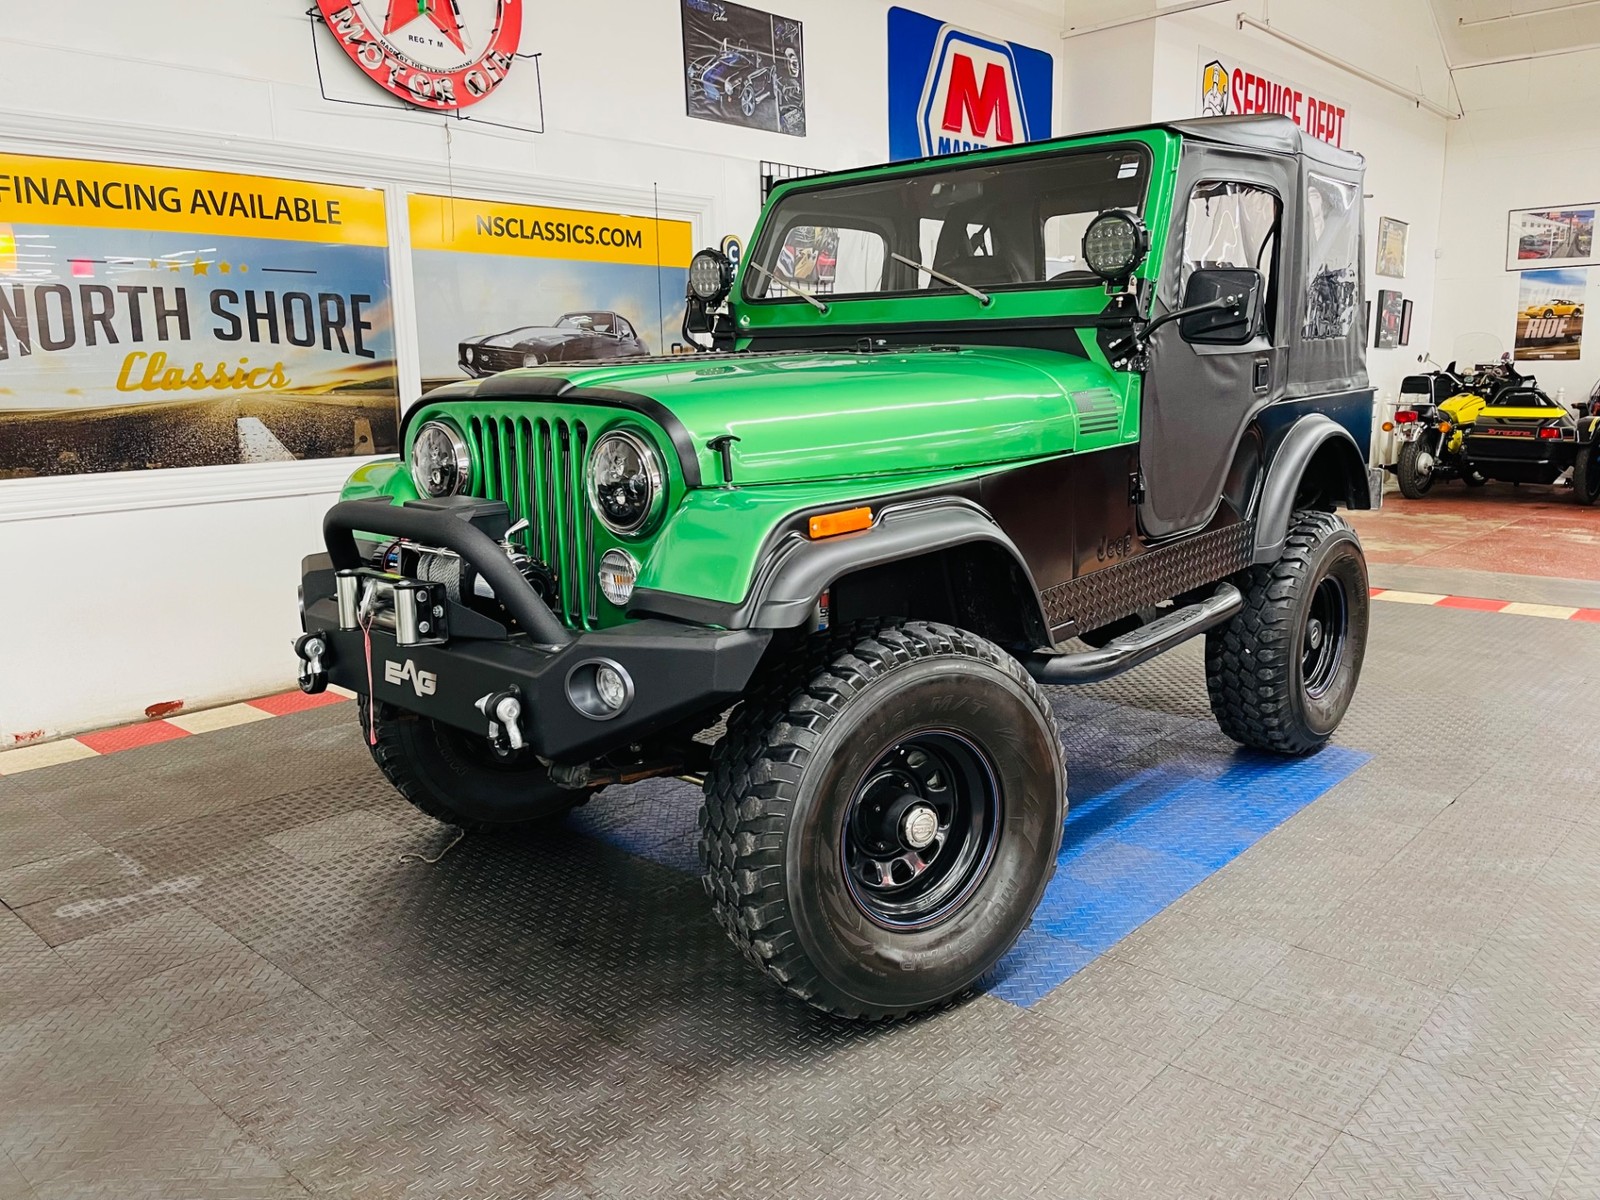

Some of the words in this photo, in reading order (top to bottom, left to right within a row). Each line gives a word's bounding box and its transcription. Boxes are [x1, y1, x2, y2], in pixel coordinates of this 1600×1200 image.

[329, 5, 457, 106] MOTOR
[408, 34, 425, 44] REG
[411, 62, 424, 71] THE
[1231, 68, 1303, 126] SERVICE
[1306, 97, 1346, 149] DEPT
[0, 174, 181, 213] FINANCING
[191, 189, 342, 225] AVAILABLE
[475, 214, 643, 249] NSCLASSICS.COM
[0, 284, 191, 361] NORTH
[210, 289, 376, 359] SHORE
[1524, 317, 1569, 339] RIDE
[116, 351, 292, 393] Classics
[1097, 531, 1132, 562] Jeep
